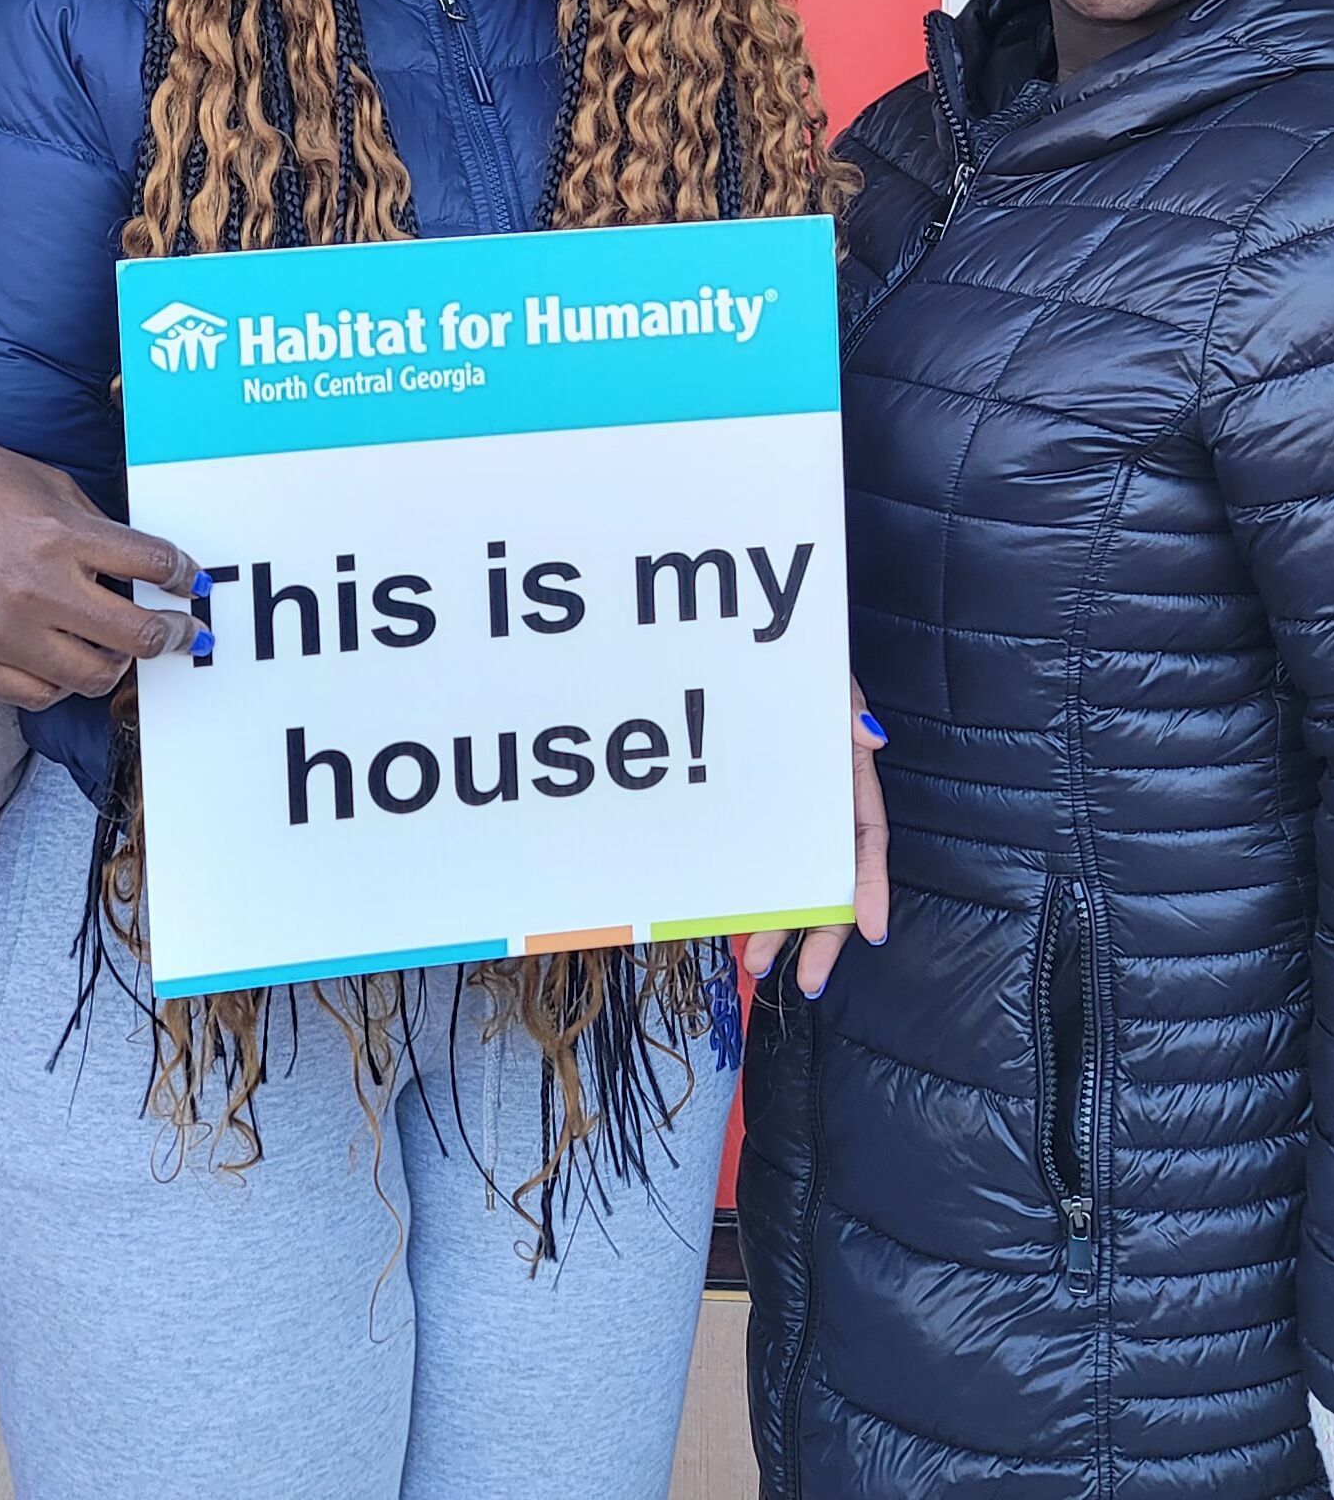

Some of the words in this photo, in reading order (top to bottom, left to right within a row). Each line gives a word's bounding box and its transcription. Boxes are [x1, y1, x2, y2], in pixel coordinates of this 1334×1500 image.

[238, 308, 428, 367] Habitat
[438, 301, 513, 351] for
[242, 374, 308, 404] North
[313, 366, 394, 398] Central
[398, 362, 486, 393] Georgia
[486, 540, 587, 638] is
[634, 542, 816, 643] my
[285, 688, 708, 826] house!
